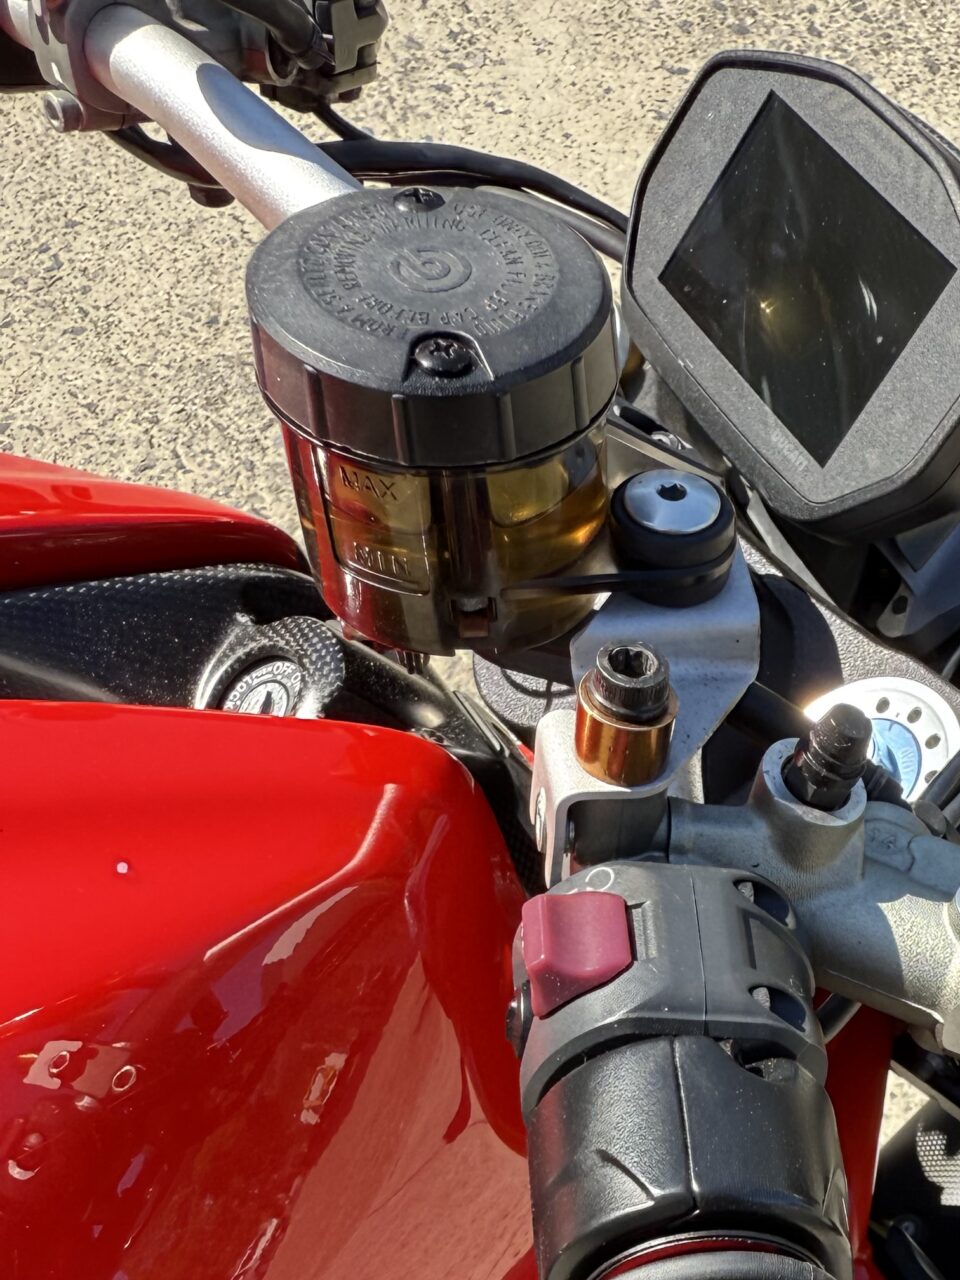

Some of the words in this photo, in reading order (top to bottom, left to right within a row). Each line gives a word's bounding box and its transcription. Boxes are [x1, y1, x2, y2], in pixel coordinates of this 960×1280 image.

[339, 465, 398, 501] MAX
[353, 541, 411, 577] MIN
[273, 662, 296, 676] OFF
